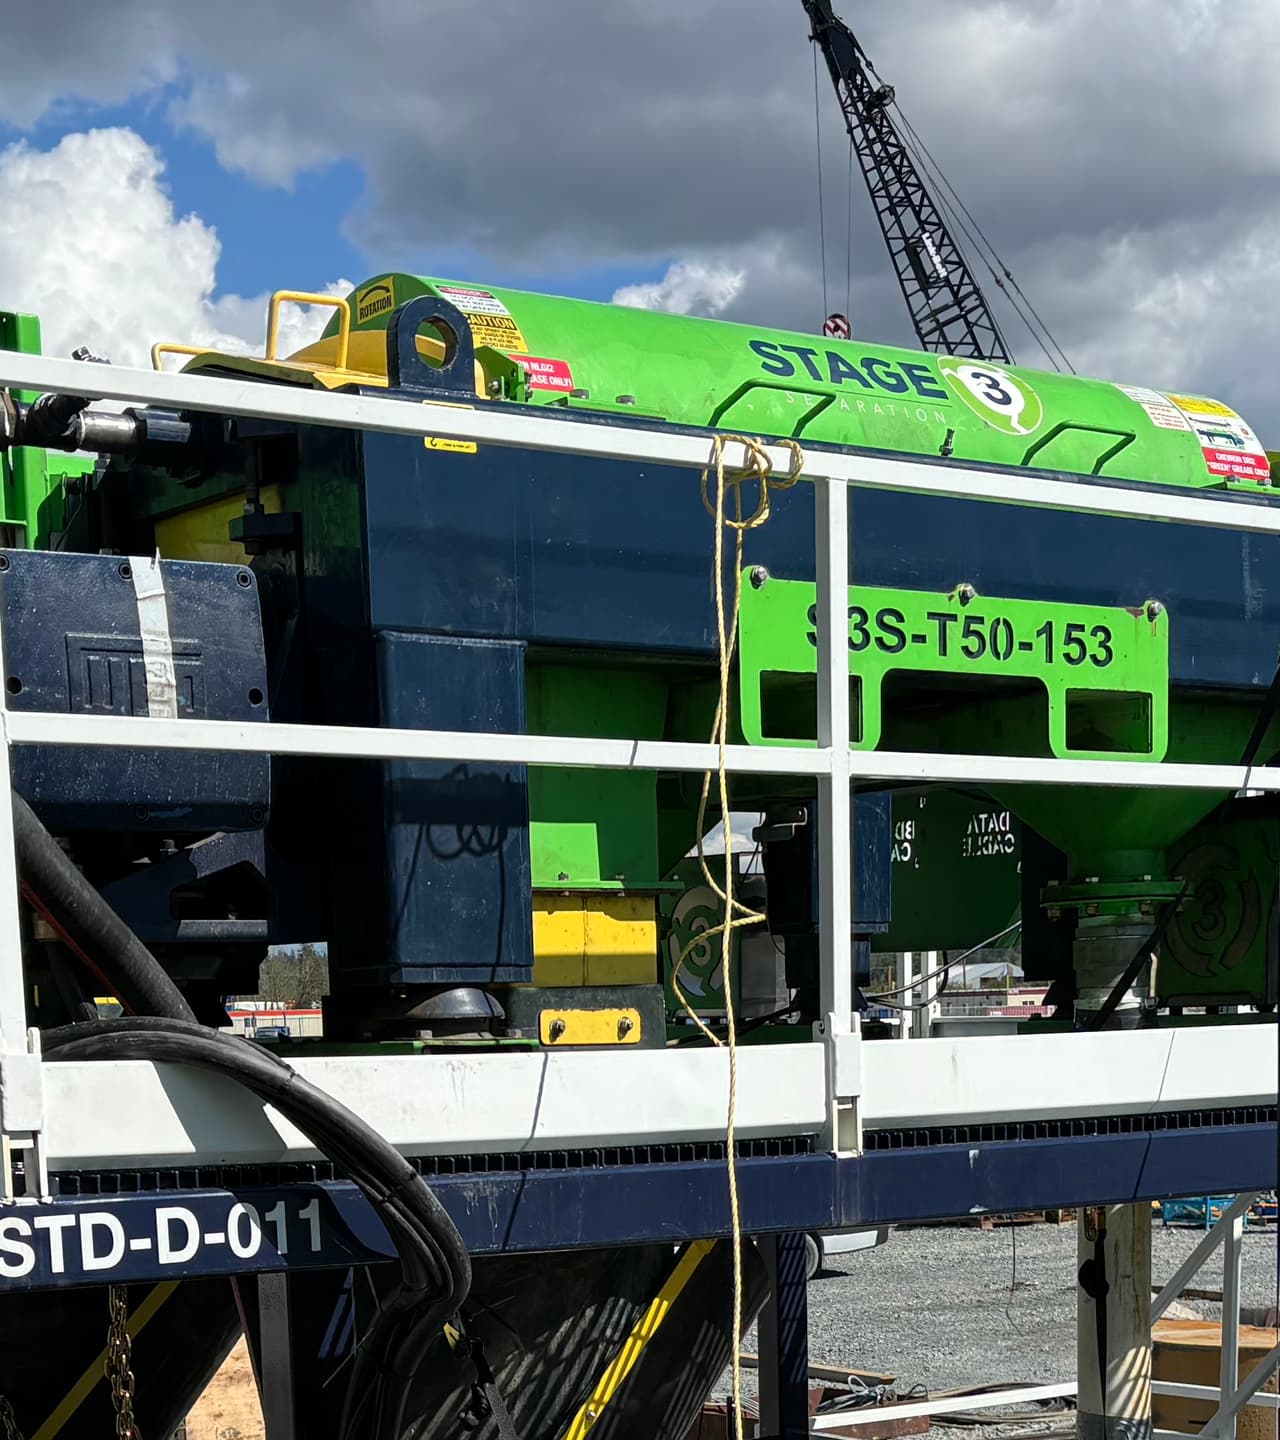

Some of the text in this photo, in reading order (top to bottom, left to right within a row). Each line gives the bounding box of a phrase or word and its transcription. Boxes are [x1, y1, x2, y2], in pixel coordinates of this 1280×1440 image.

[360, 294, 393, 320] ROTATION
[466, 314, 515, 329] AUTION
[749, 340, 1012, 405] STAGE 3
[784, 390, 947, 424] SEARATION
